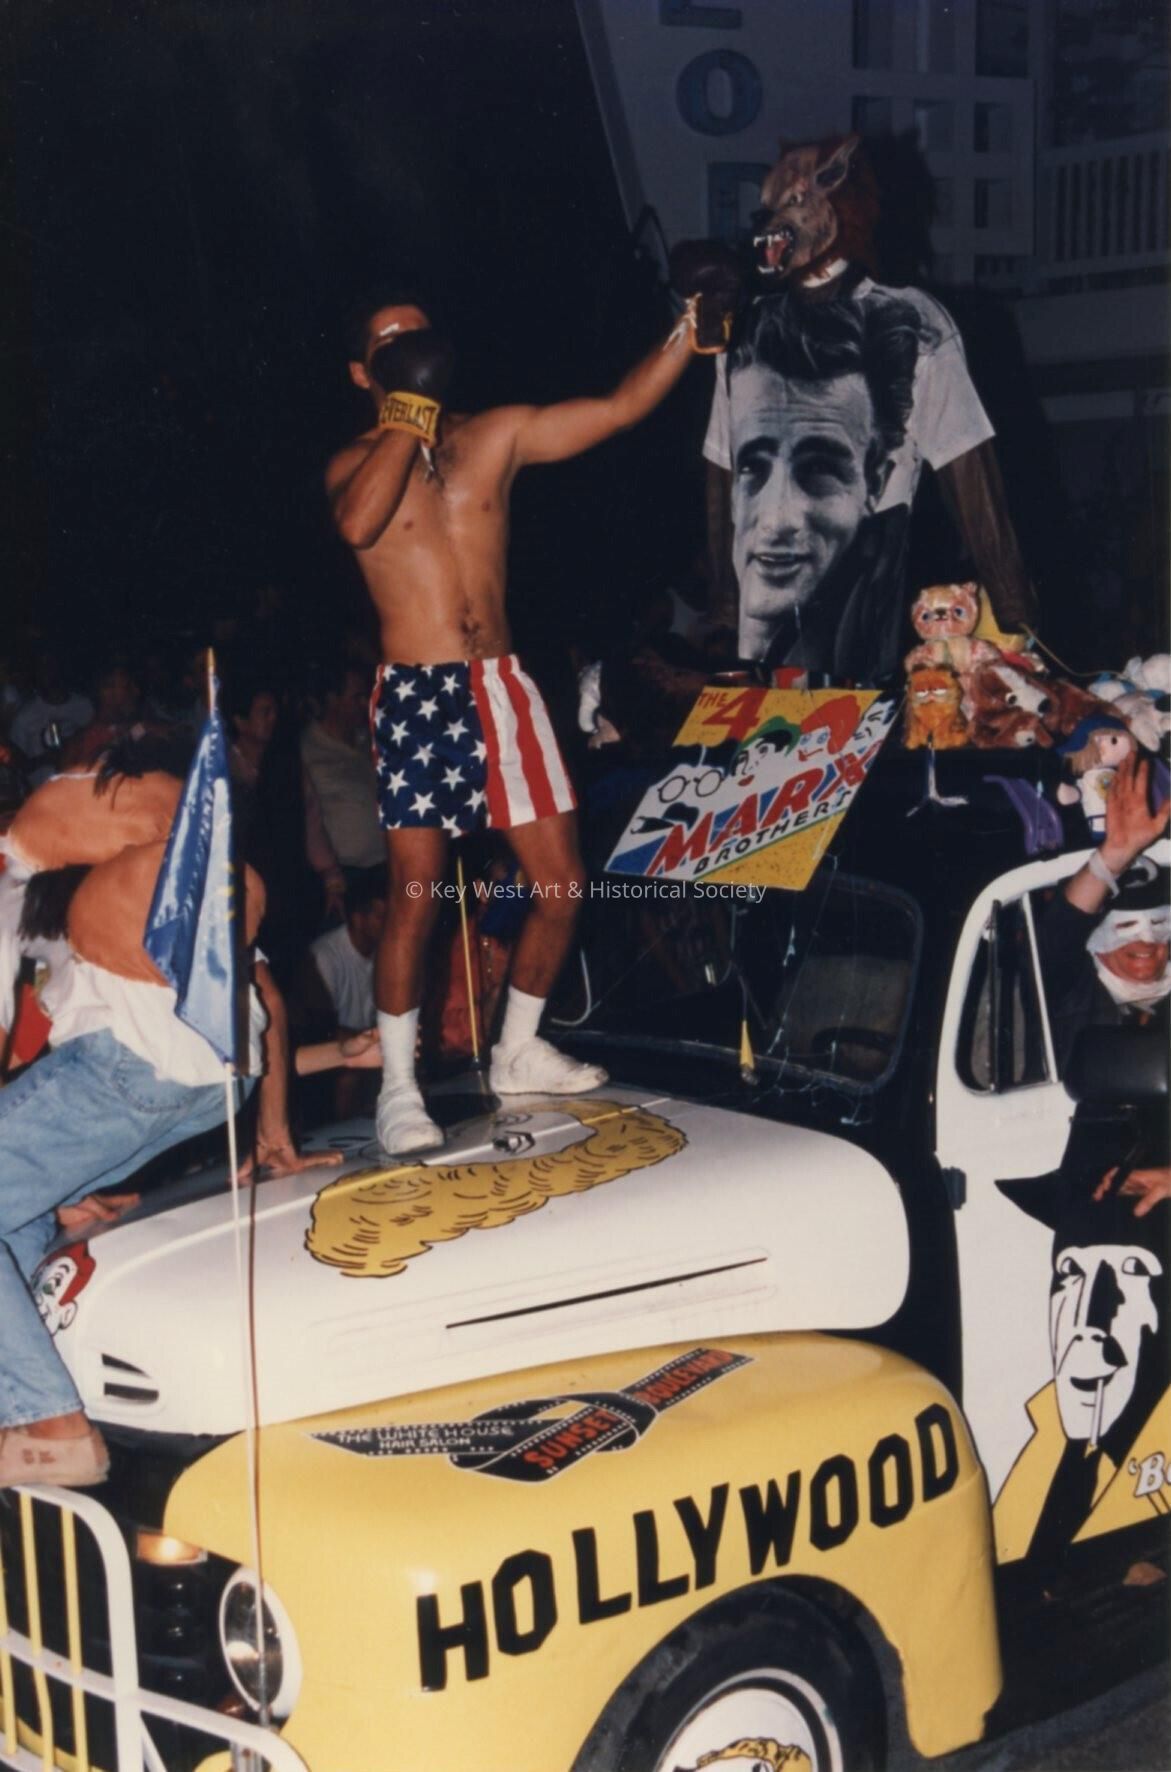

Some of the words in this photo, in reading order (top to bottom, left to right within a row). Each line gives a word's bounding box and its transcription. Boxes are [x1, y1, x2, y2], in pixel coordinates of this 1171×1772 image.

[381, 396, 437, 436] EVERLAST
[698, 691, 729, 708] THE
[702, 688, 769, 740] 4
[646, 740, 882, 876] MARX
[694, 789, 852, 874] BROTHERS
[338, 1433, 371, 1444] THE
[377, 1428, 440, 1441] WHITE
[445, 1425, 514, 1438] HOUSE
[379, 1440, 415, 1449] HAIR
[419, 1438, 472, 1448] SALON
[523, 1409, 619, 1469] SUNSET
[416, 1402, 960, 1693] HOLLYWOOD
